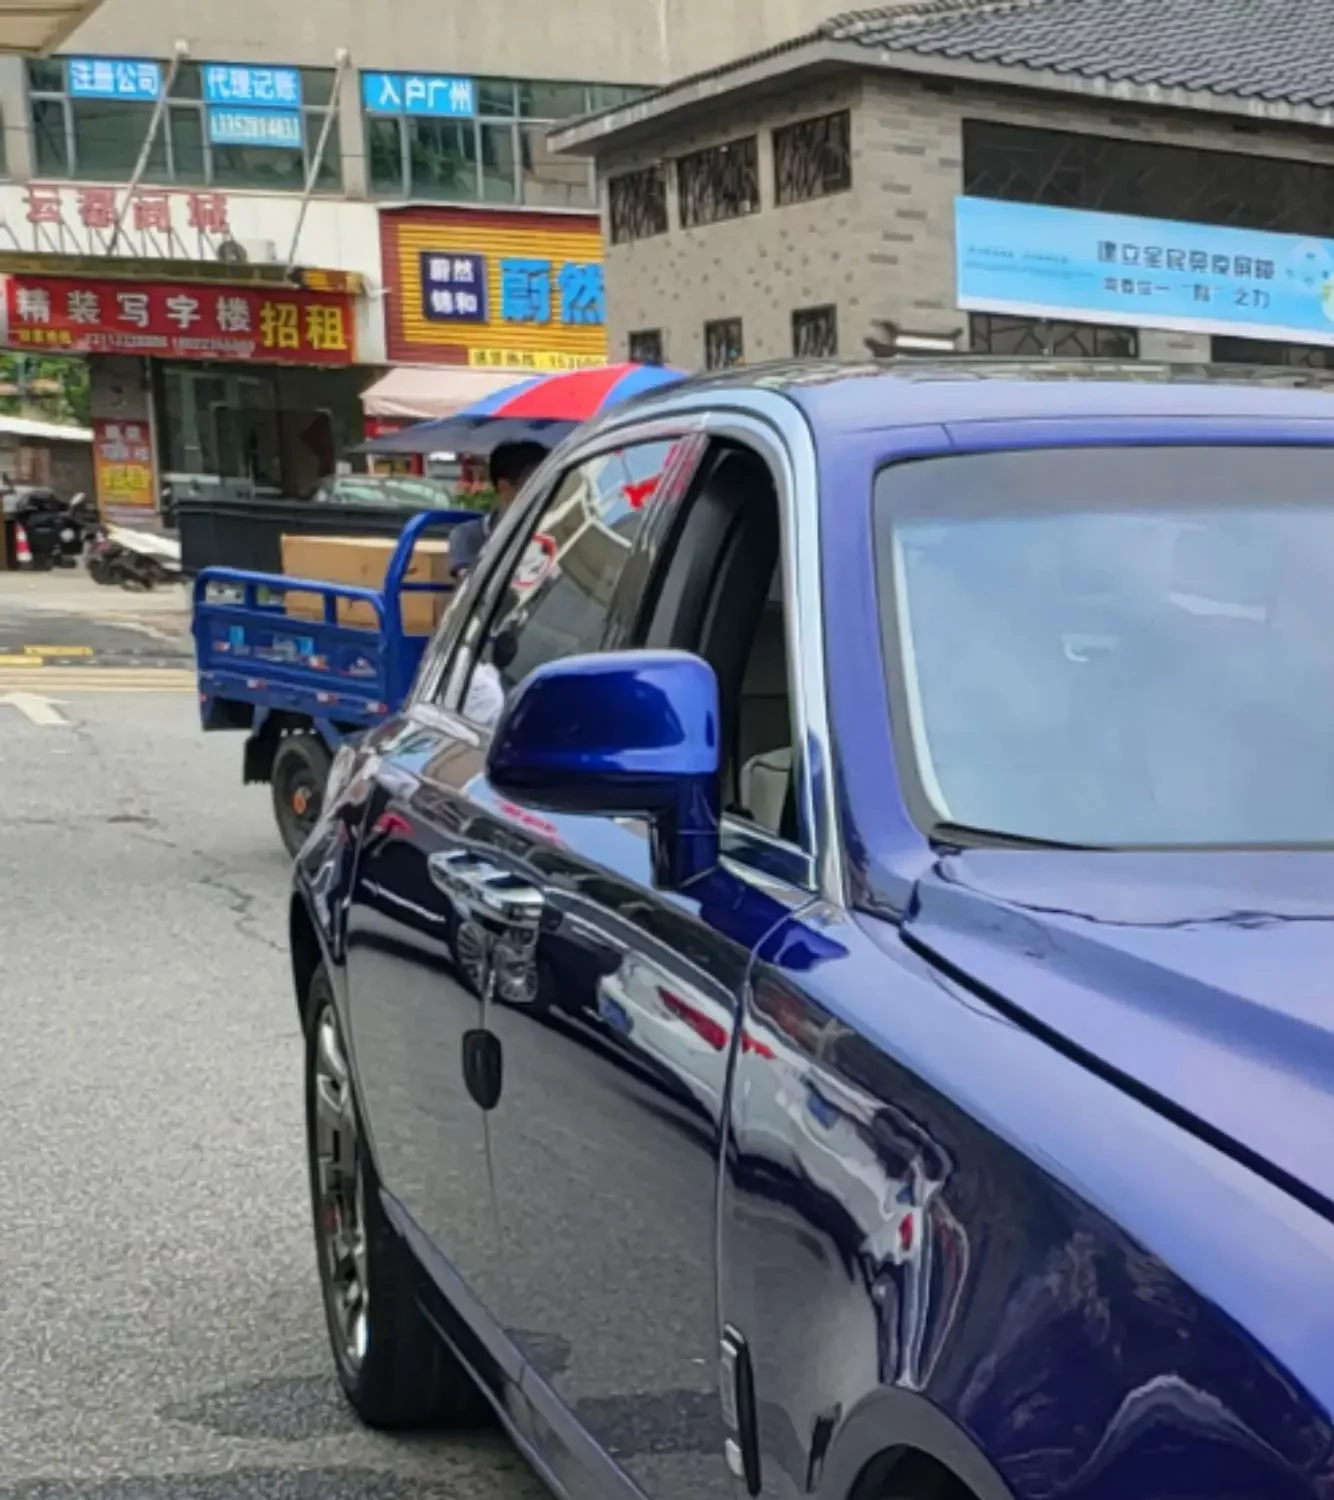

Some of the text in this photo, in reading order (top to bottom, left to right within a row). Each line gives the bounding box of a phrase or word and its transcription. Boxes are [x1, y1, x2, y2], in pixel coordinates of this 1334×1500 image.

[71, 60, 160, 95] 注册公司
[379, 73, 472, 112] 入户广州
[17, 287, 251, 333] 精装写字楼
[259, 302, 348, 350] 招租
